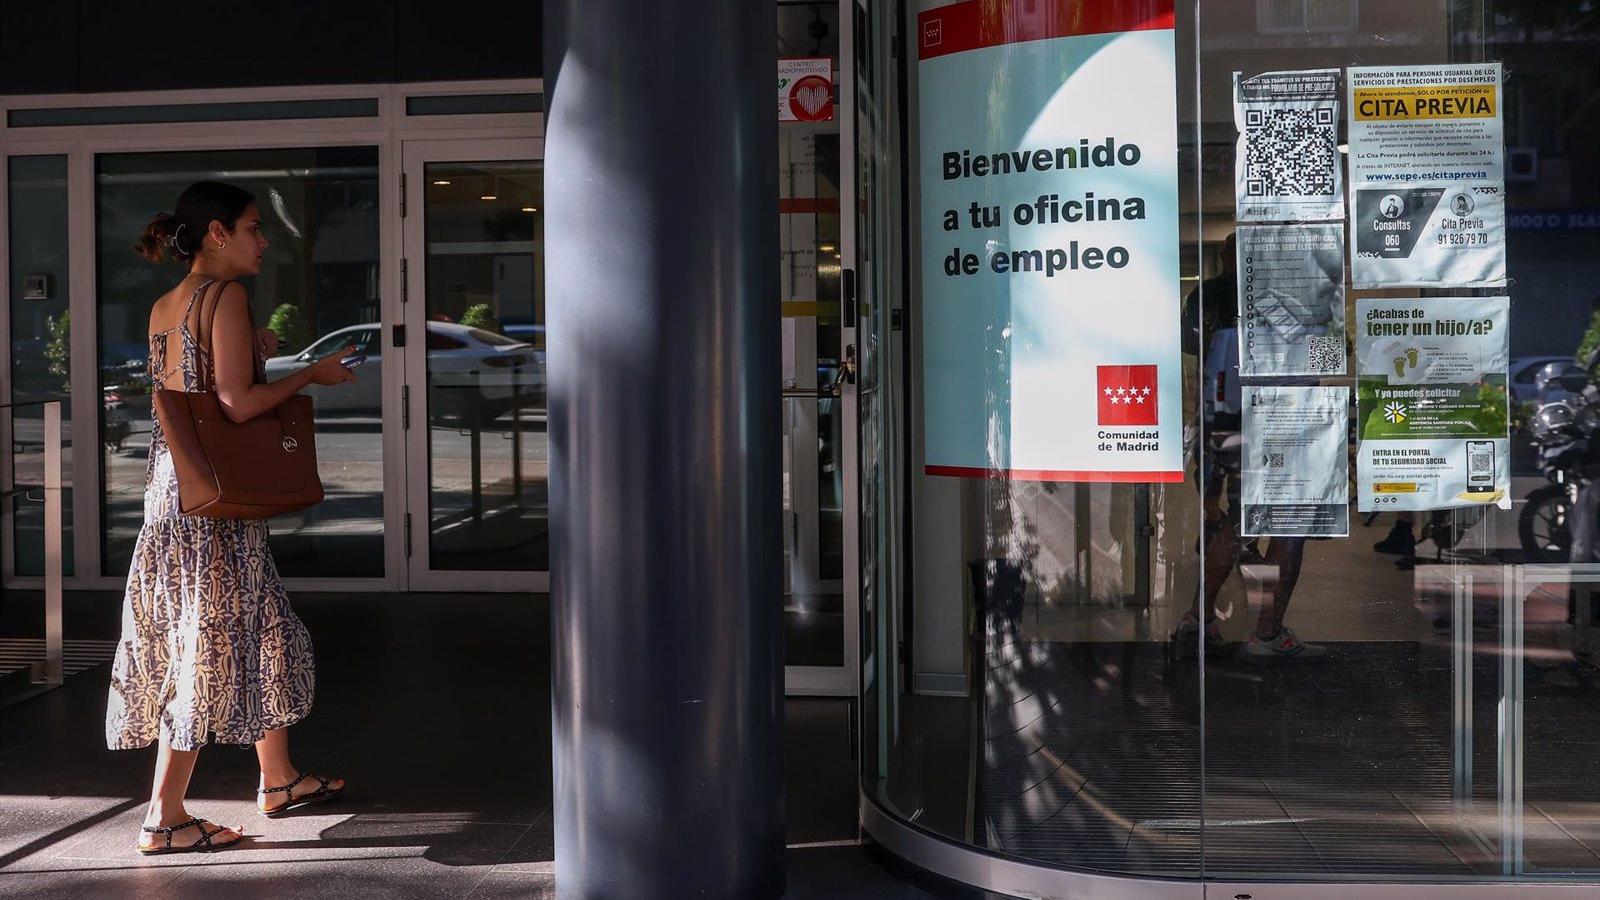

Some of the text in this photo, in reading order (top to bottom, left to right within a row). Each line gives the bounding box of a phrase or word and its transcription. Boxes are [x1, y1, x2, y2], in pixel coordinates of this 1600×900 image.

[1359, 96, 1492, 117] CITA PREVIA
[943, 137, 1141, 180] Bienvenido
[1366, 170, 1487, 182] www.sepe.es/citaprevia
[943, 192, 1146, 231] a tu oficina
[1373, 219, 1411, 231] Consultas
[1442, 218, 1484, 229] Cita Previa
[1385, 234, 1400, 246] 060
[1438, 233, 1488, 244] 91 926 79 70
[944, 240, 1130, 278] de empleo
[1367, 308, 1424, 320] ¿Acabas de
[1367, 319, 1494, 337] tener un hijo/a?
[1375, 389, 1460, 398] Y ya puedes solicitar
[1097, 430, 1160, 441] Comunidad
[1098, 441, 1160, 452] de Madrid
